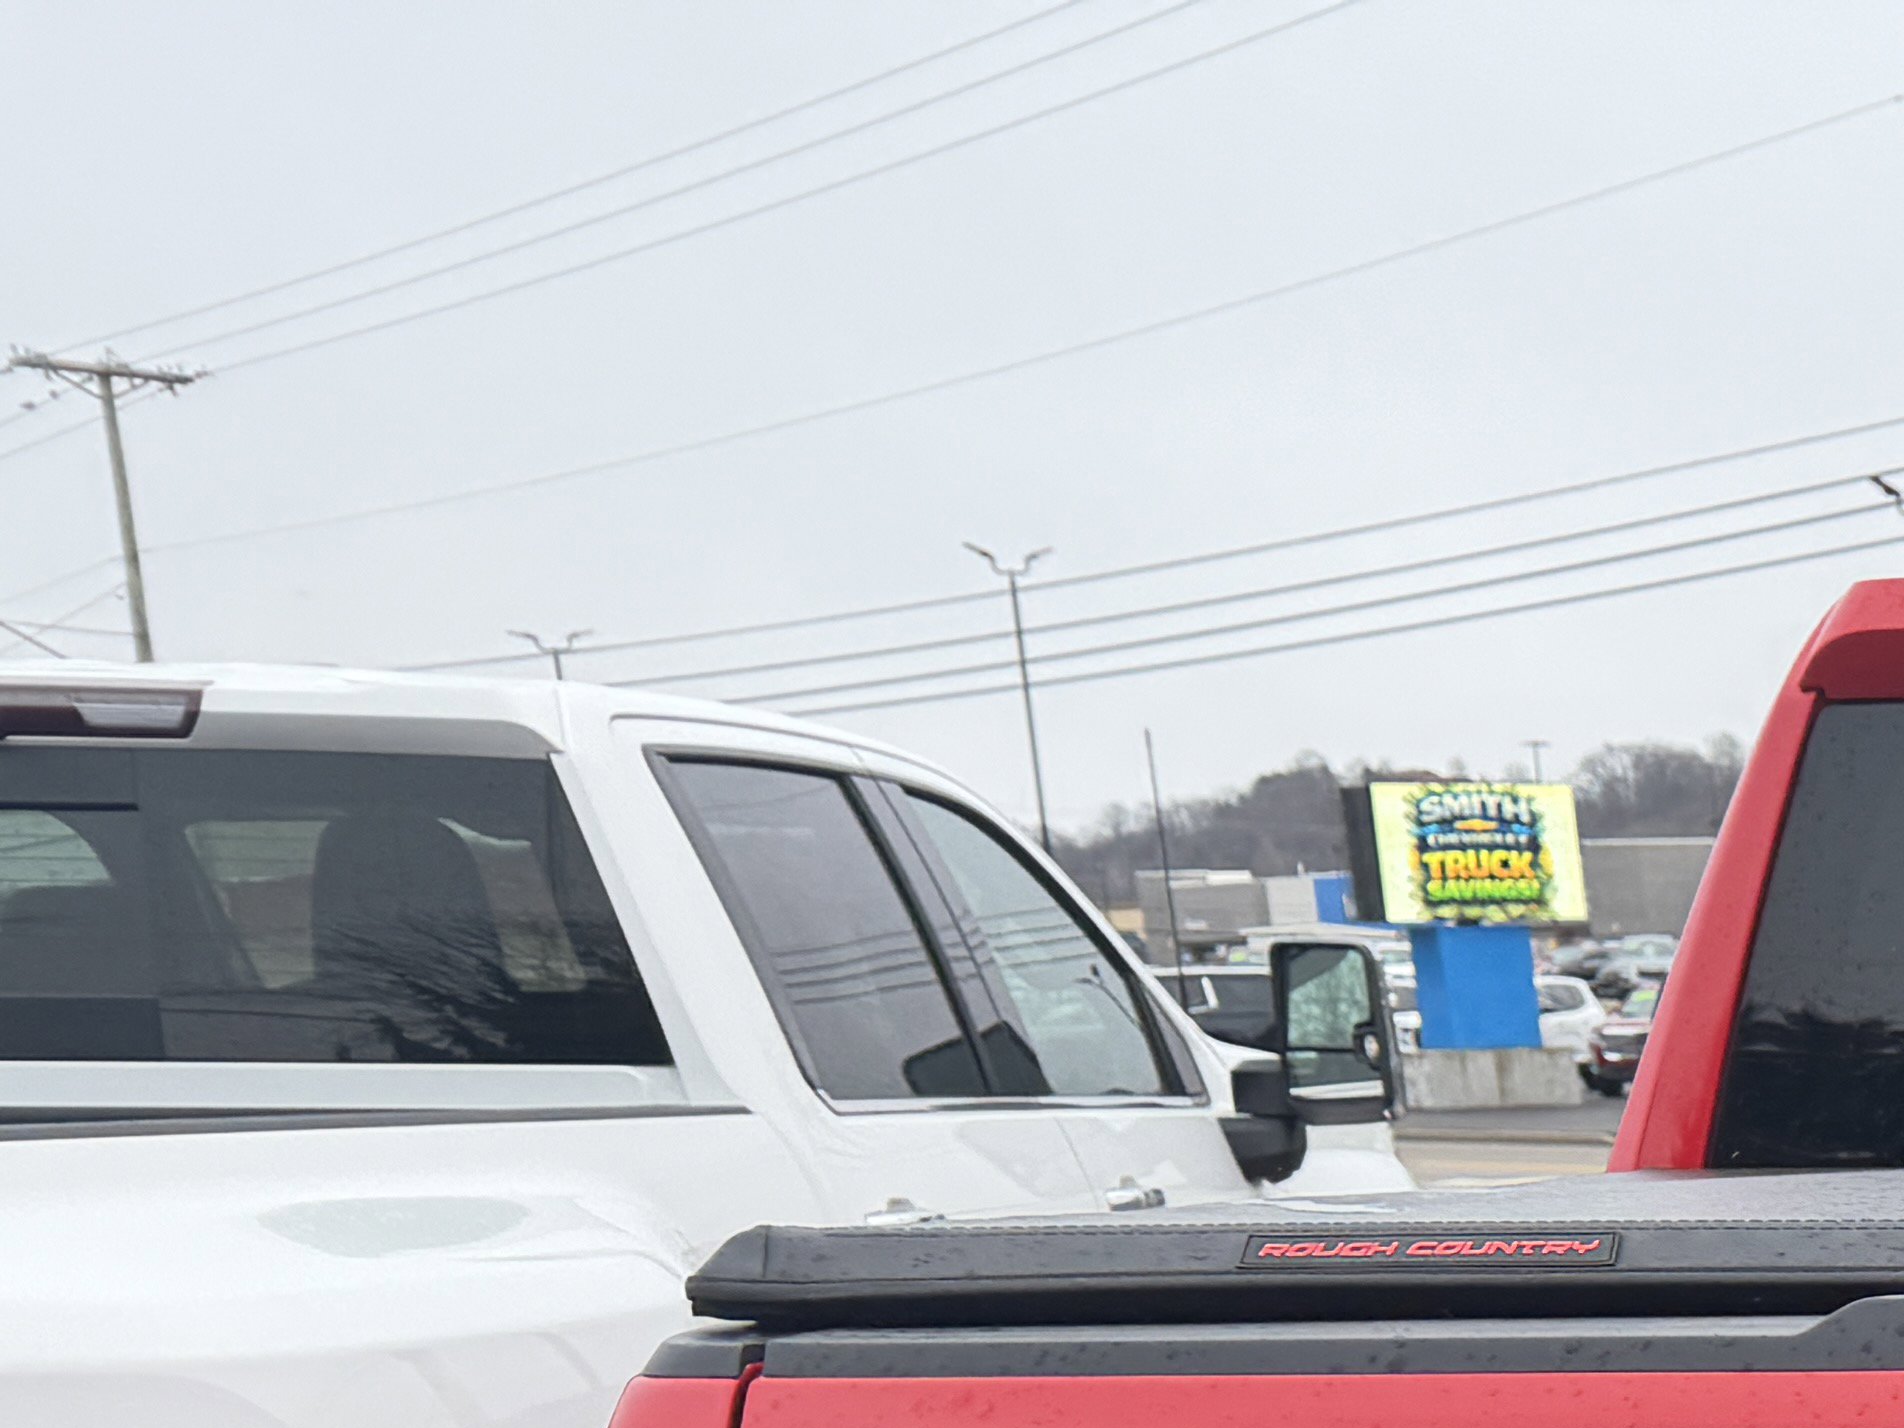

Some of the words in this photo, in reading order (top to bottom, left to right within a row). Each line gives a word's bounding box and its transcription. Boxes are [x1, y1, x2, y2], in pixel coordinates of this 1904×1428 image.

[1418, 792, 1533, 826] SMITH
[1421, 848, 1536, 880] TRUCK
[1257, 1241, 1399, 1258] ROUGH
[1406, 1239, 1601, 1256] COUNTRY
